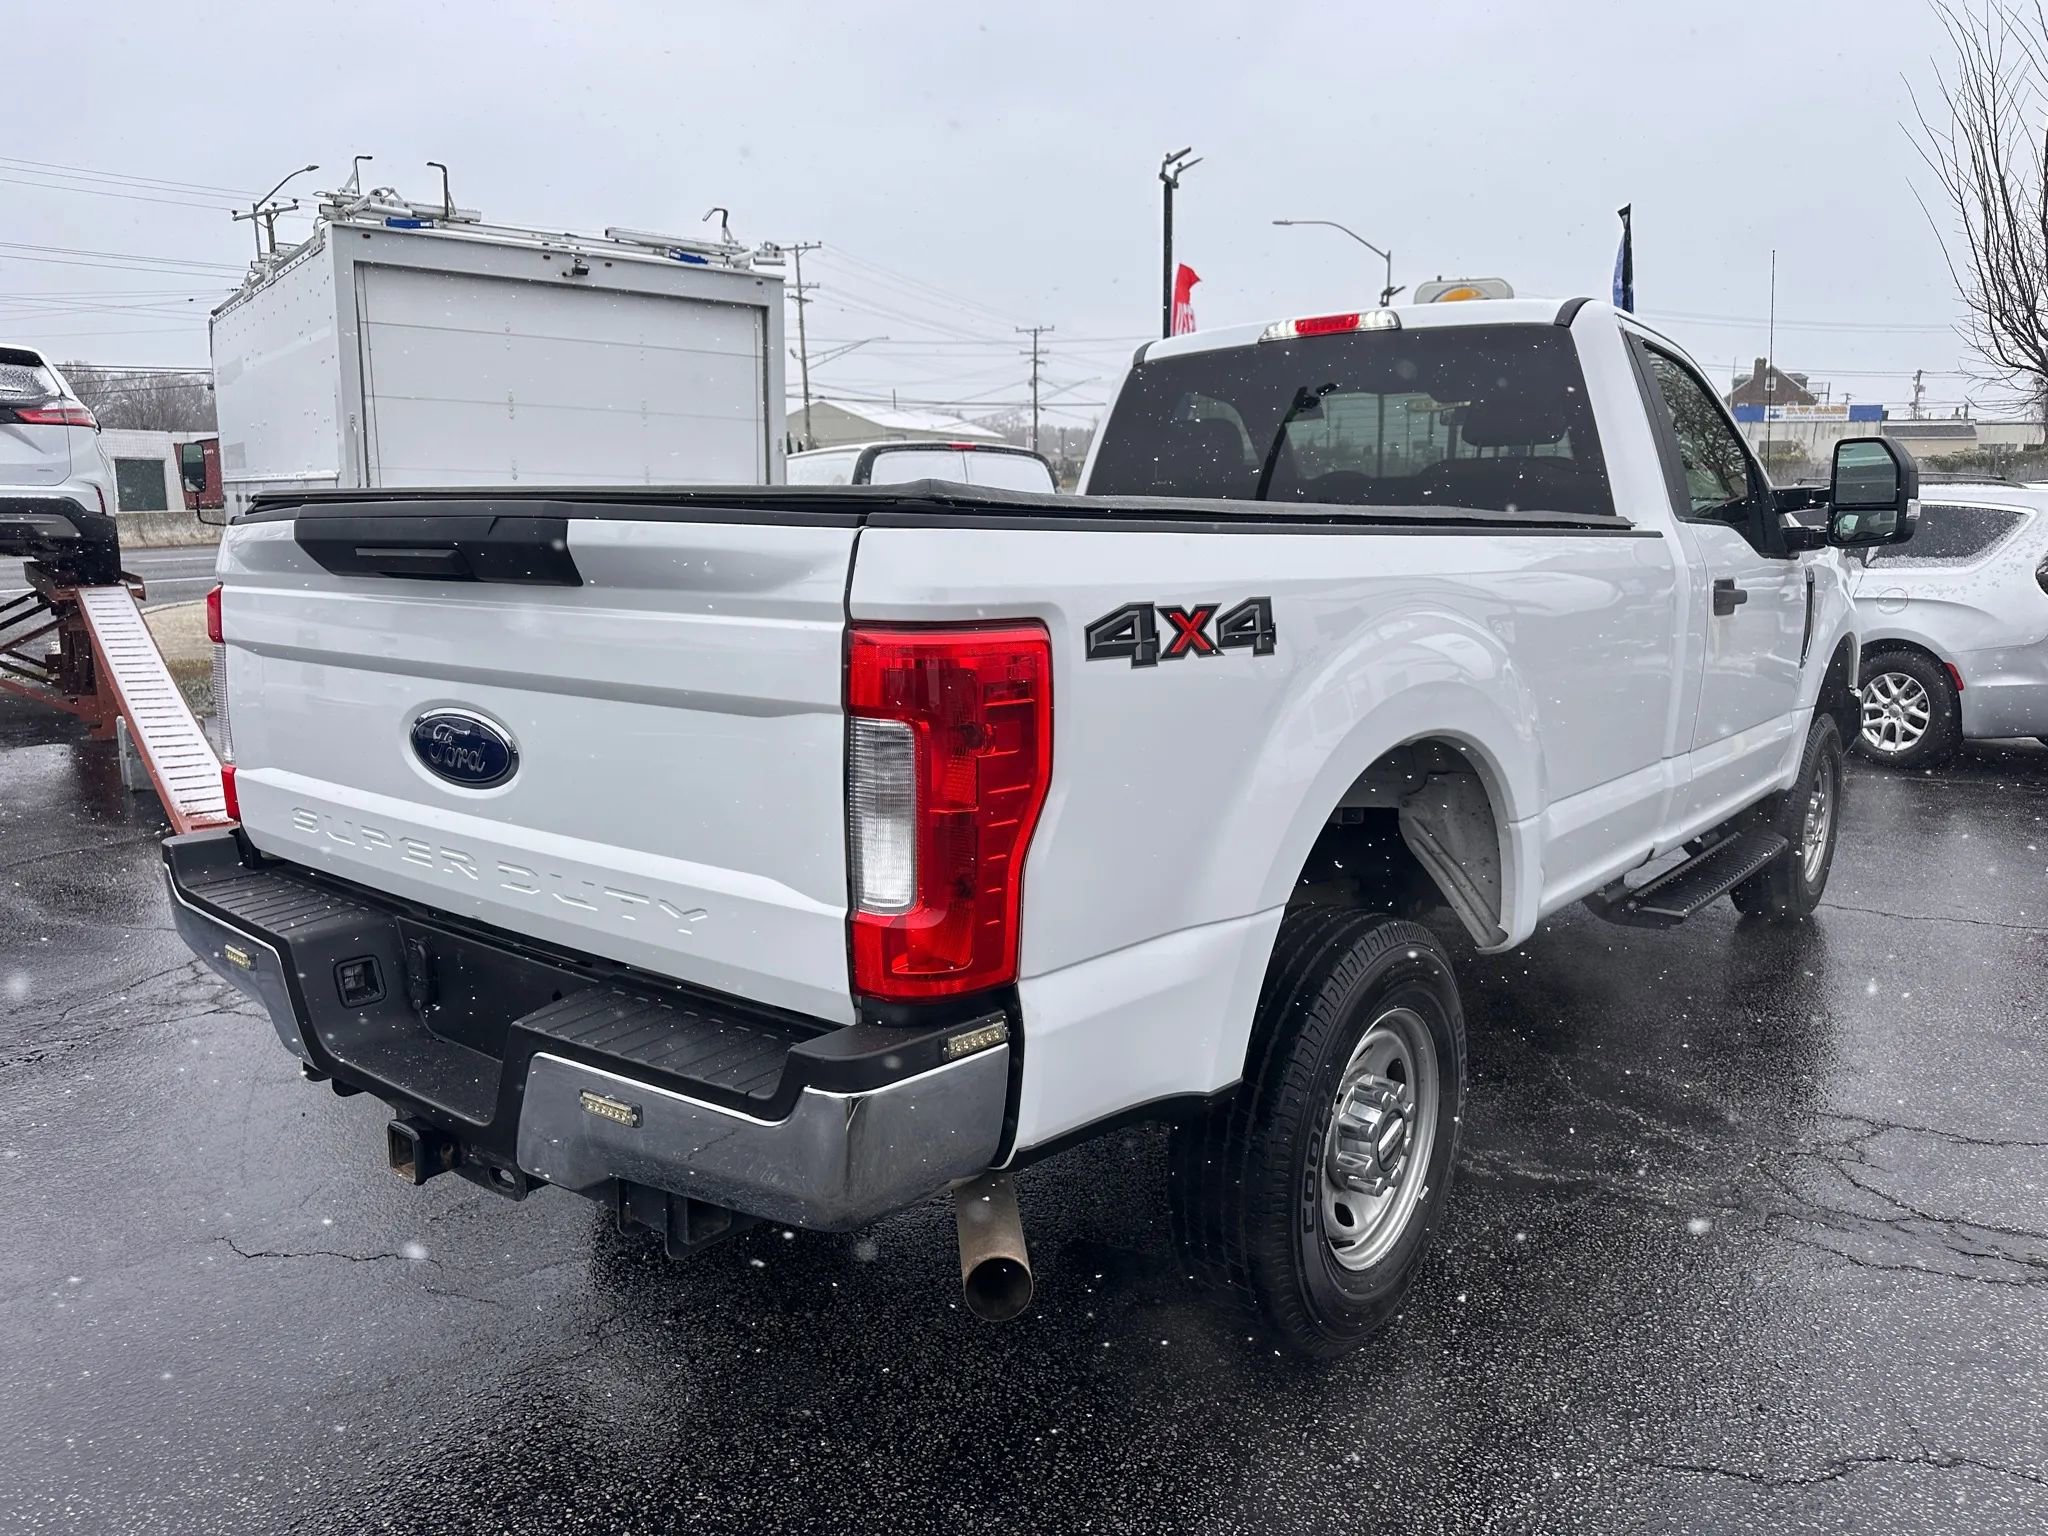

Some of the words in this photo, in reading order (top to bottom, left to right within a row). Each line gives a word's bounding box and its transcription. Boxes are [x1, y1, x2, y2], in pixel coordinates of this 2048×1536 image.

[430, 723, 486, 773] Ford
[291, 806, 479, 881] SUPER
[497, 860, 708, 934] DUTY
